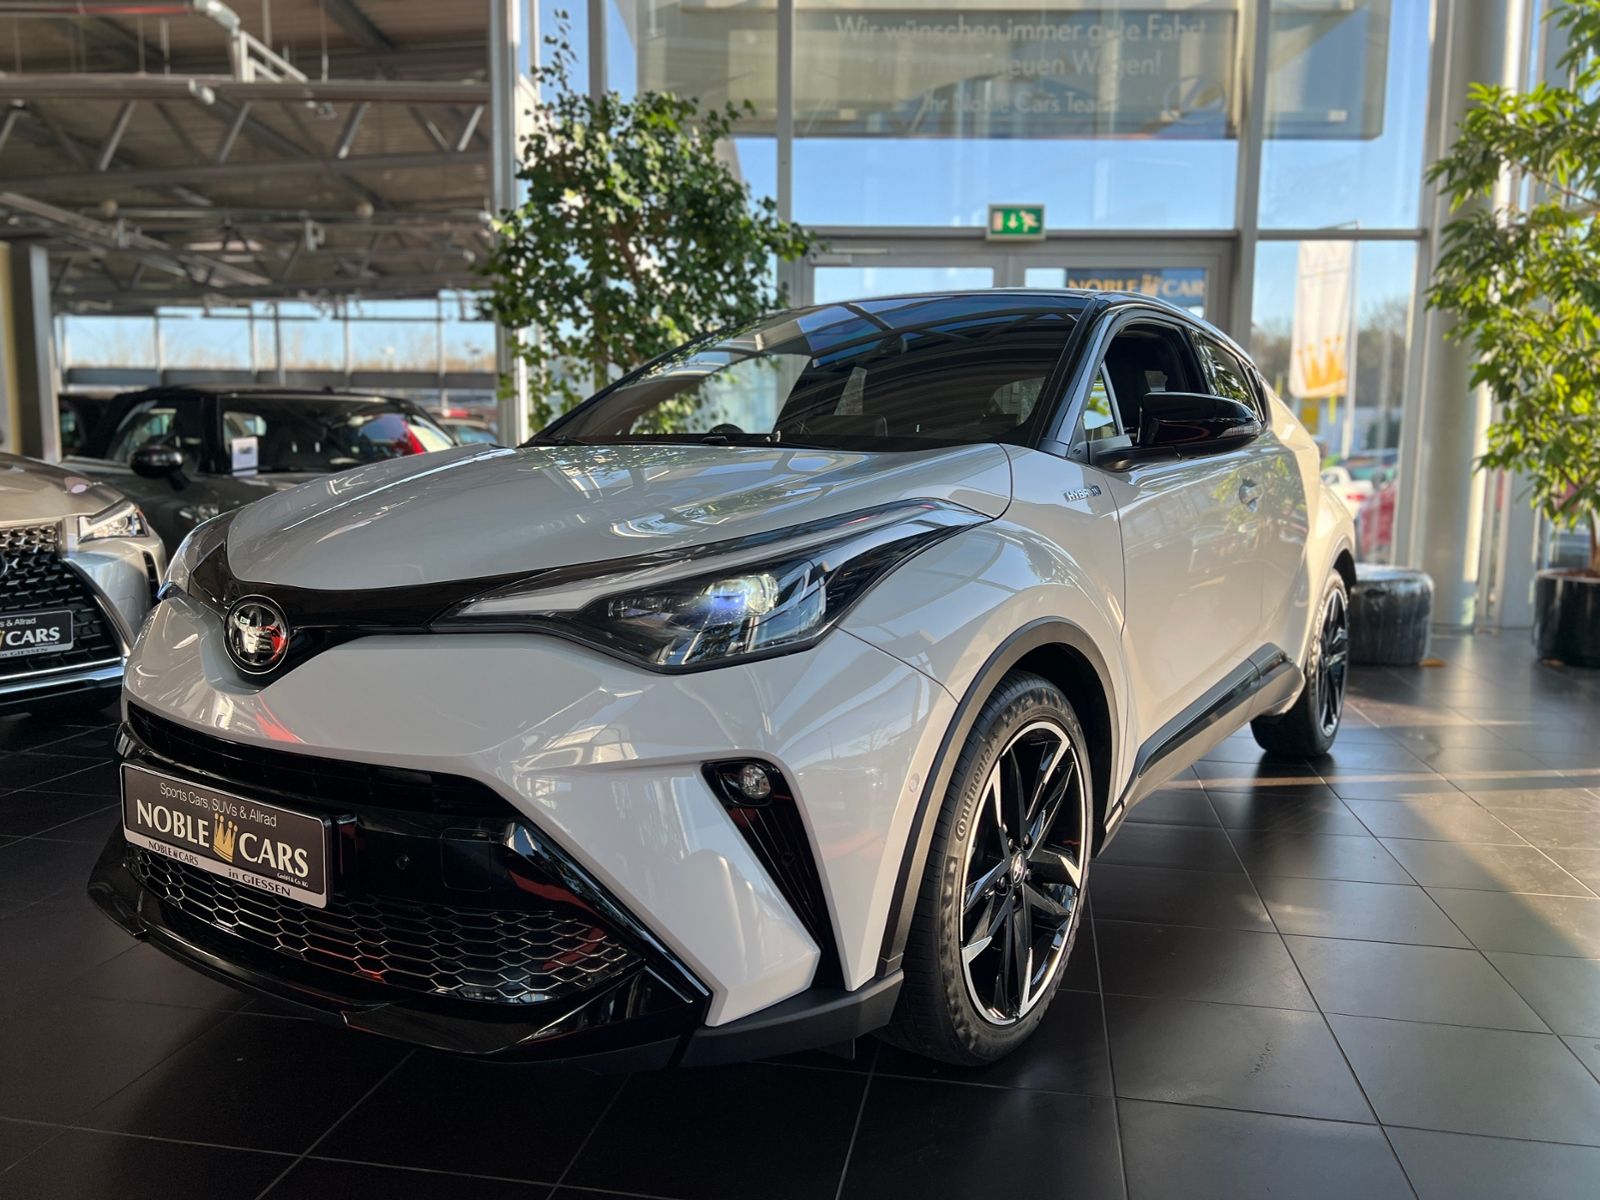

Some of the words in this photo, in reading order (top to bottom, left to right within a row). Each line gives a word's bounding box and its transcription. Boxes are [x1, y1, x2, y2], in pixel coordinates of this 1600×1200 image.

[835, 14, 879, 41] Wir
[883, 14, 1001, 42] wünschen
[1006, 17, 1083, 42] immer
[1087, 17, 1141, 46] gte
[995, 58, 1066, 78] euen
[1071, 48, 1161, 79] Wen!
[924, 92, 948, 113] hr
[953, 92, 1010, 113] Noe
[1014, 91, 1060, 113] Cars
[1067, 278, 1138, 292] NOBLE
[5, 626, 60, 646] CARS
[14, 617, 37, 626] Allrad
[159, 783, 188, 803] Sports
[188, 791, 210, 810] Cars,
[211, 799, 238, 817] SUVs
[239, 805, 247, 820] &
[249, 808, 277, 827] Allrad
[955, 741, 994, 842] Continental
[136, 799, 210, 848] NOBLE
[239, 832, 309, 878] CARS
[148, 840, 173, 858] NOBLE
[178, 851, 199, 866] CARS
[228, 868, 239, 880] in
[242, 873, 291, 897] GIESSEN
